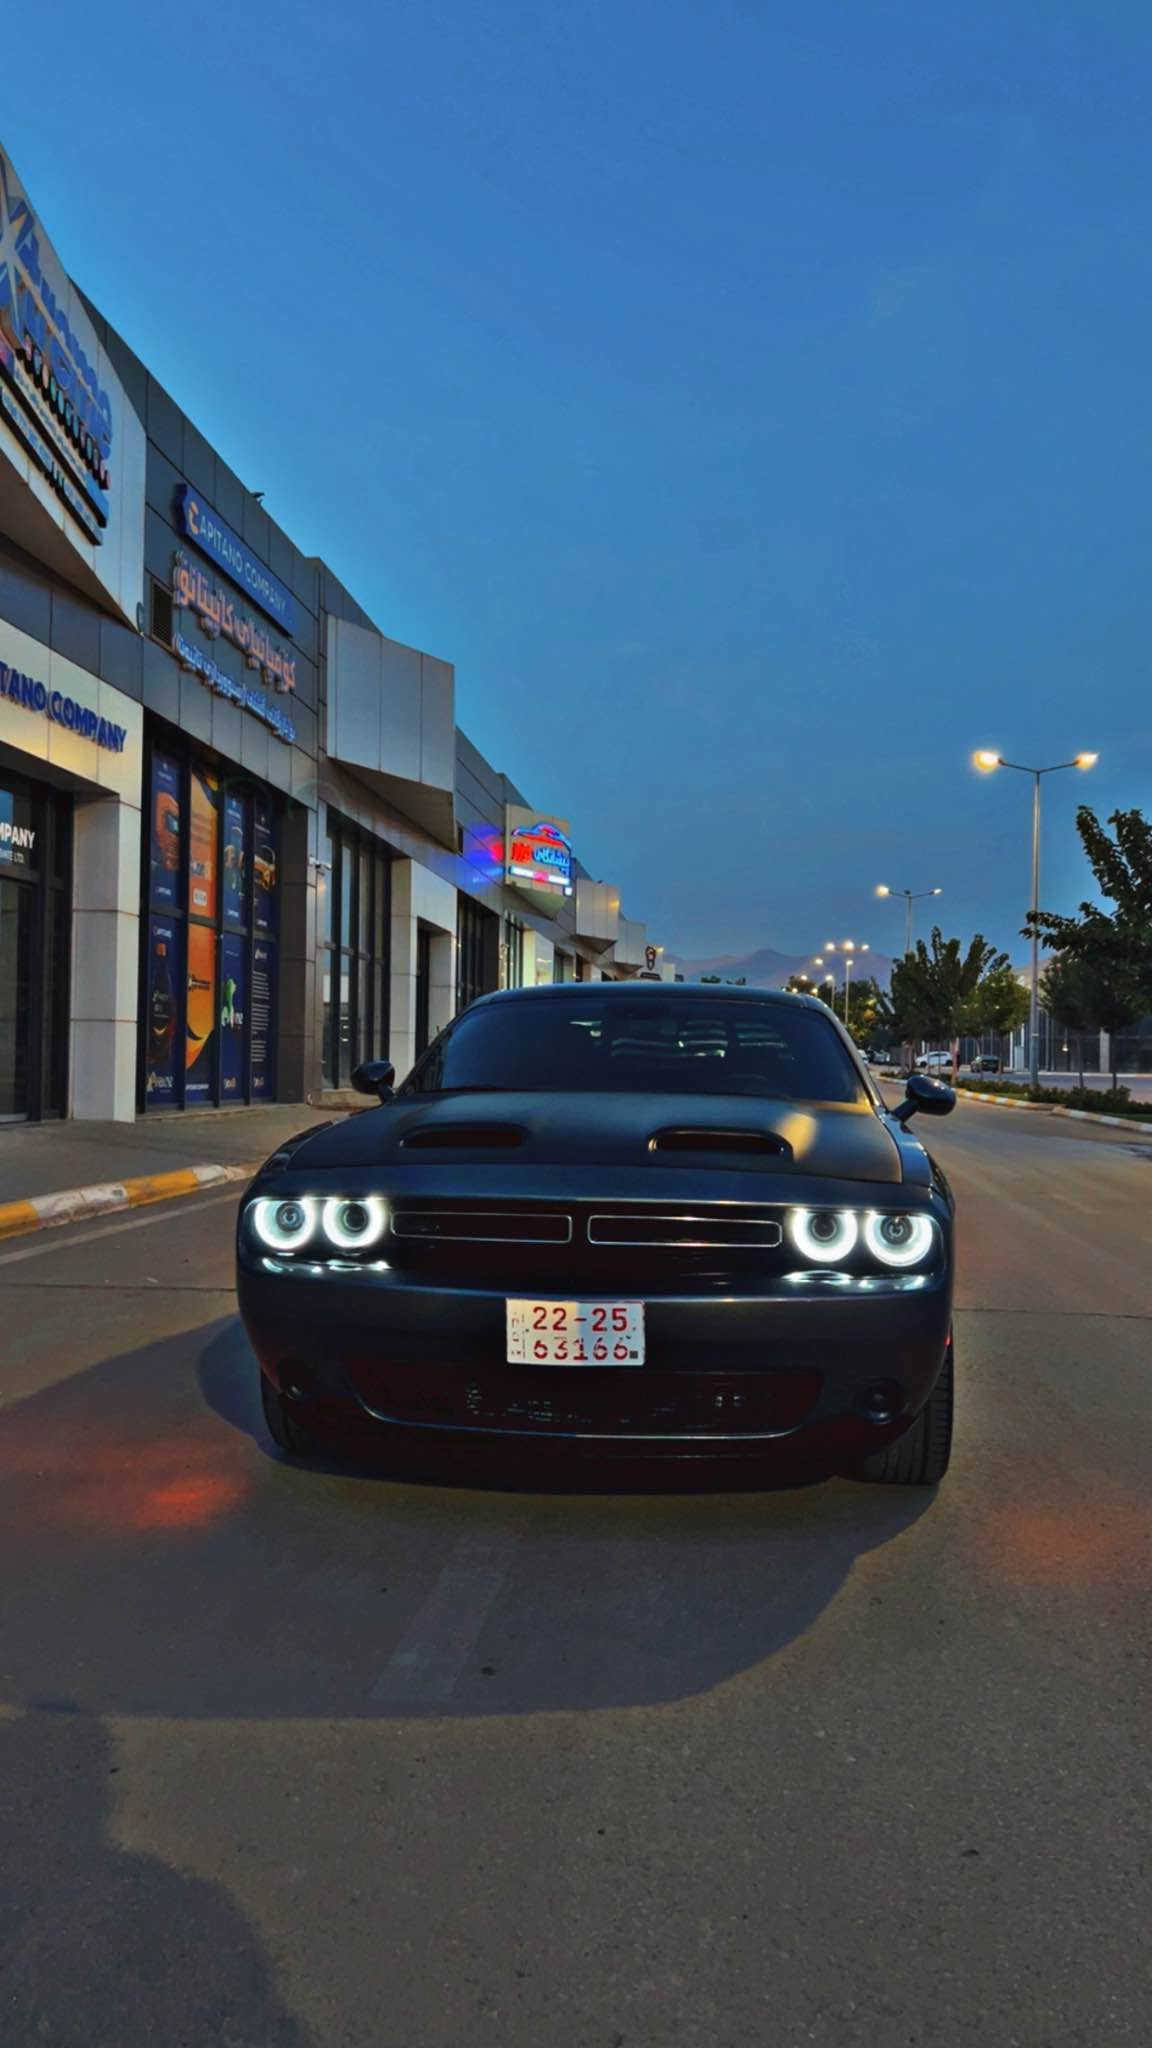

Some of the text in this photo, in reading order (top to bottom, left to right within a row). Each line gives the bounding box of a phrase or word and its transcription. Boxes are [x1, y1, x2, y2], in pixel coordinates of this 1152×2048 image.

[188, 501, 243, 572] CAPITANO
[50, 690, 127, 753] COMPANY
[532, 1306, 628, 1332] 22-25
[533, 1337, 629, 1360] 63166
